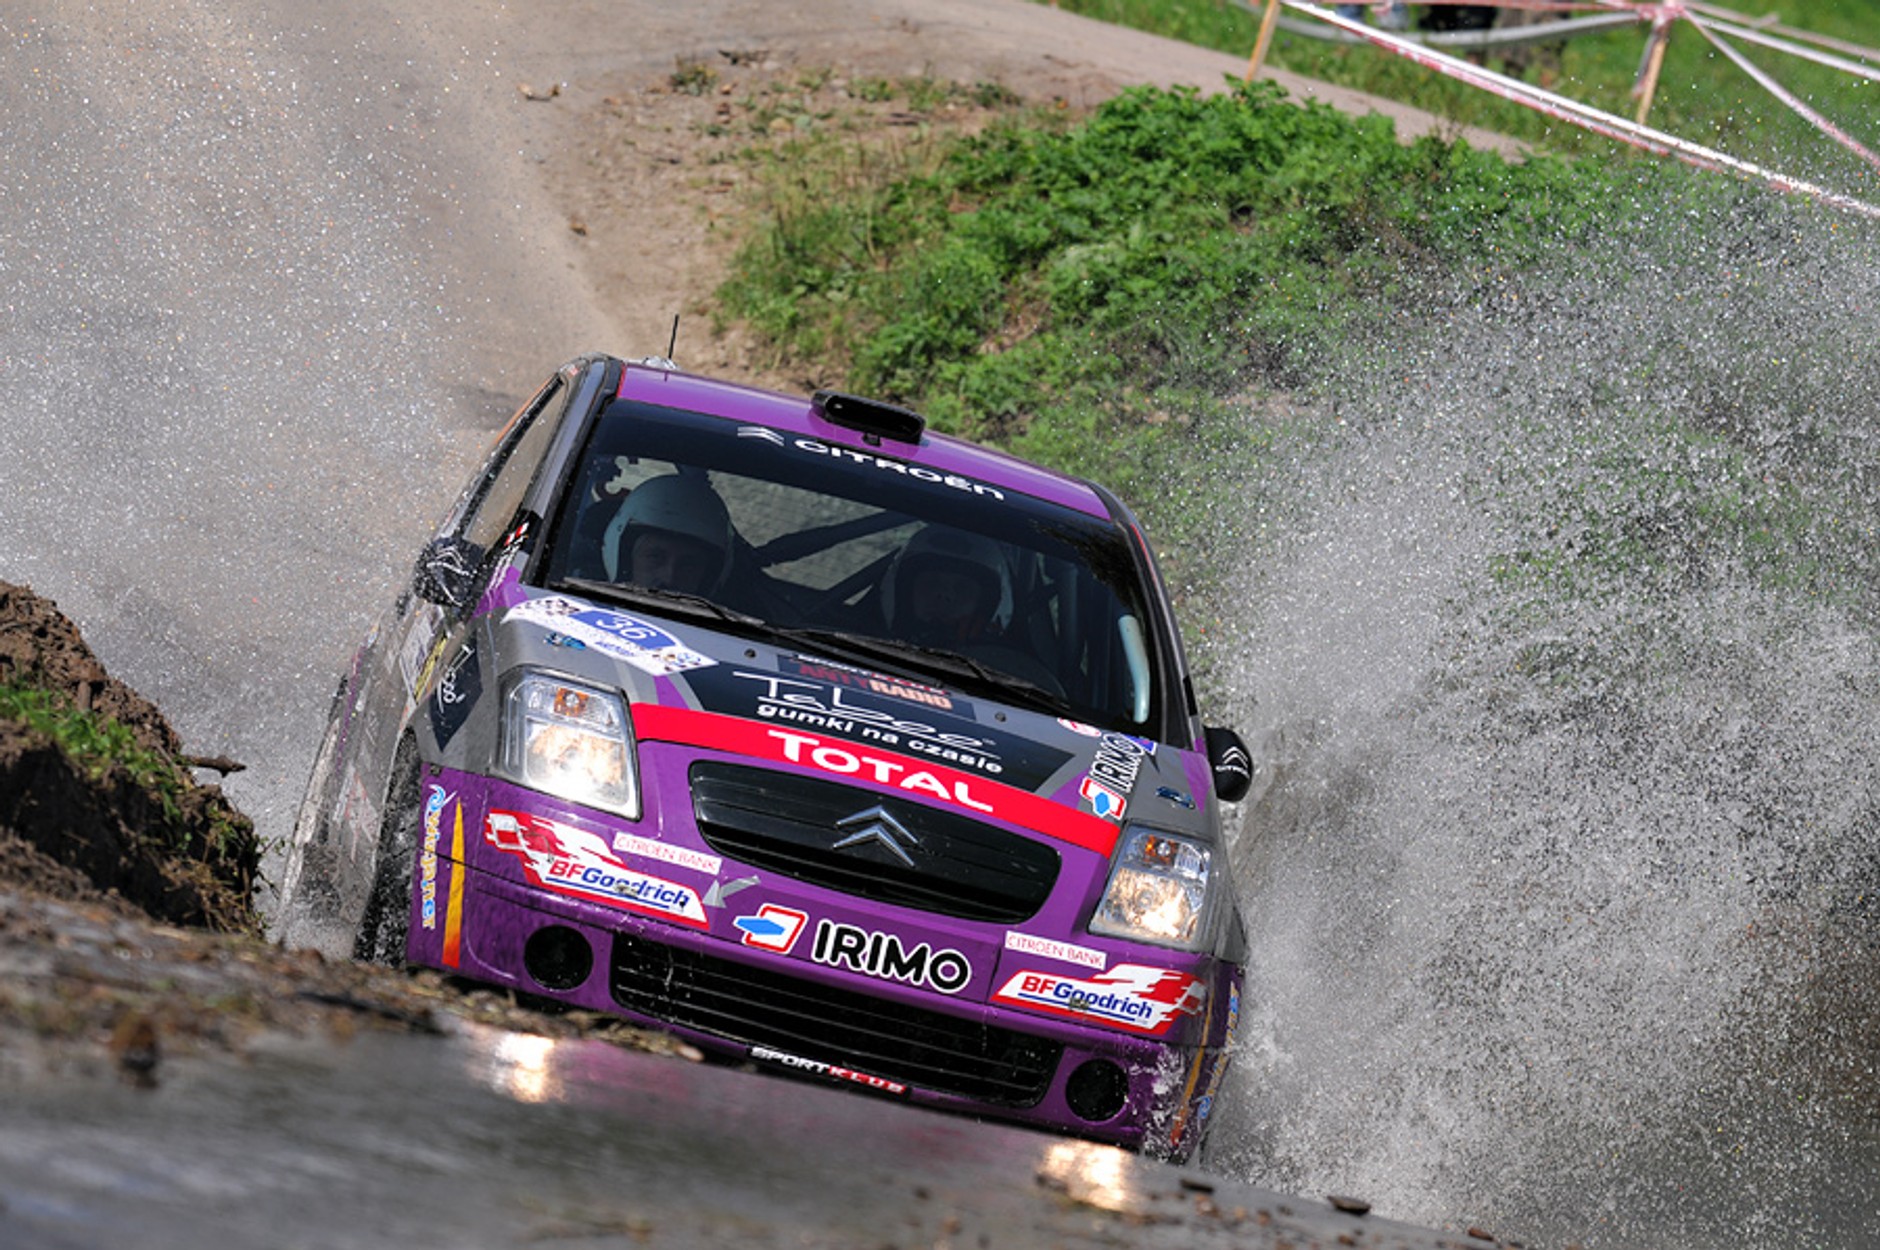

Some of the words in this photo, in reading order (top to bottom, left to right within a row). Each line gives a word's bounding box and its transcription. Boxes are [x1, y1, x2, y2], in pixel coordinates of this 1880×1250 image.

[595, 614, 657, 640] 36
[757, 703, 854, 733] gumki
[862, 726, 899, 745] na
[908, 739, 1003, 774] czasie
[768, 730, 994, 812] TOTAL
[549, 860, 690, 908] BFGoodrich
[812, 920, 971, 993] IRIMO
[1021, 975, 1154, 1020] BFGoodrich
